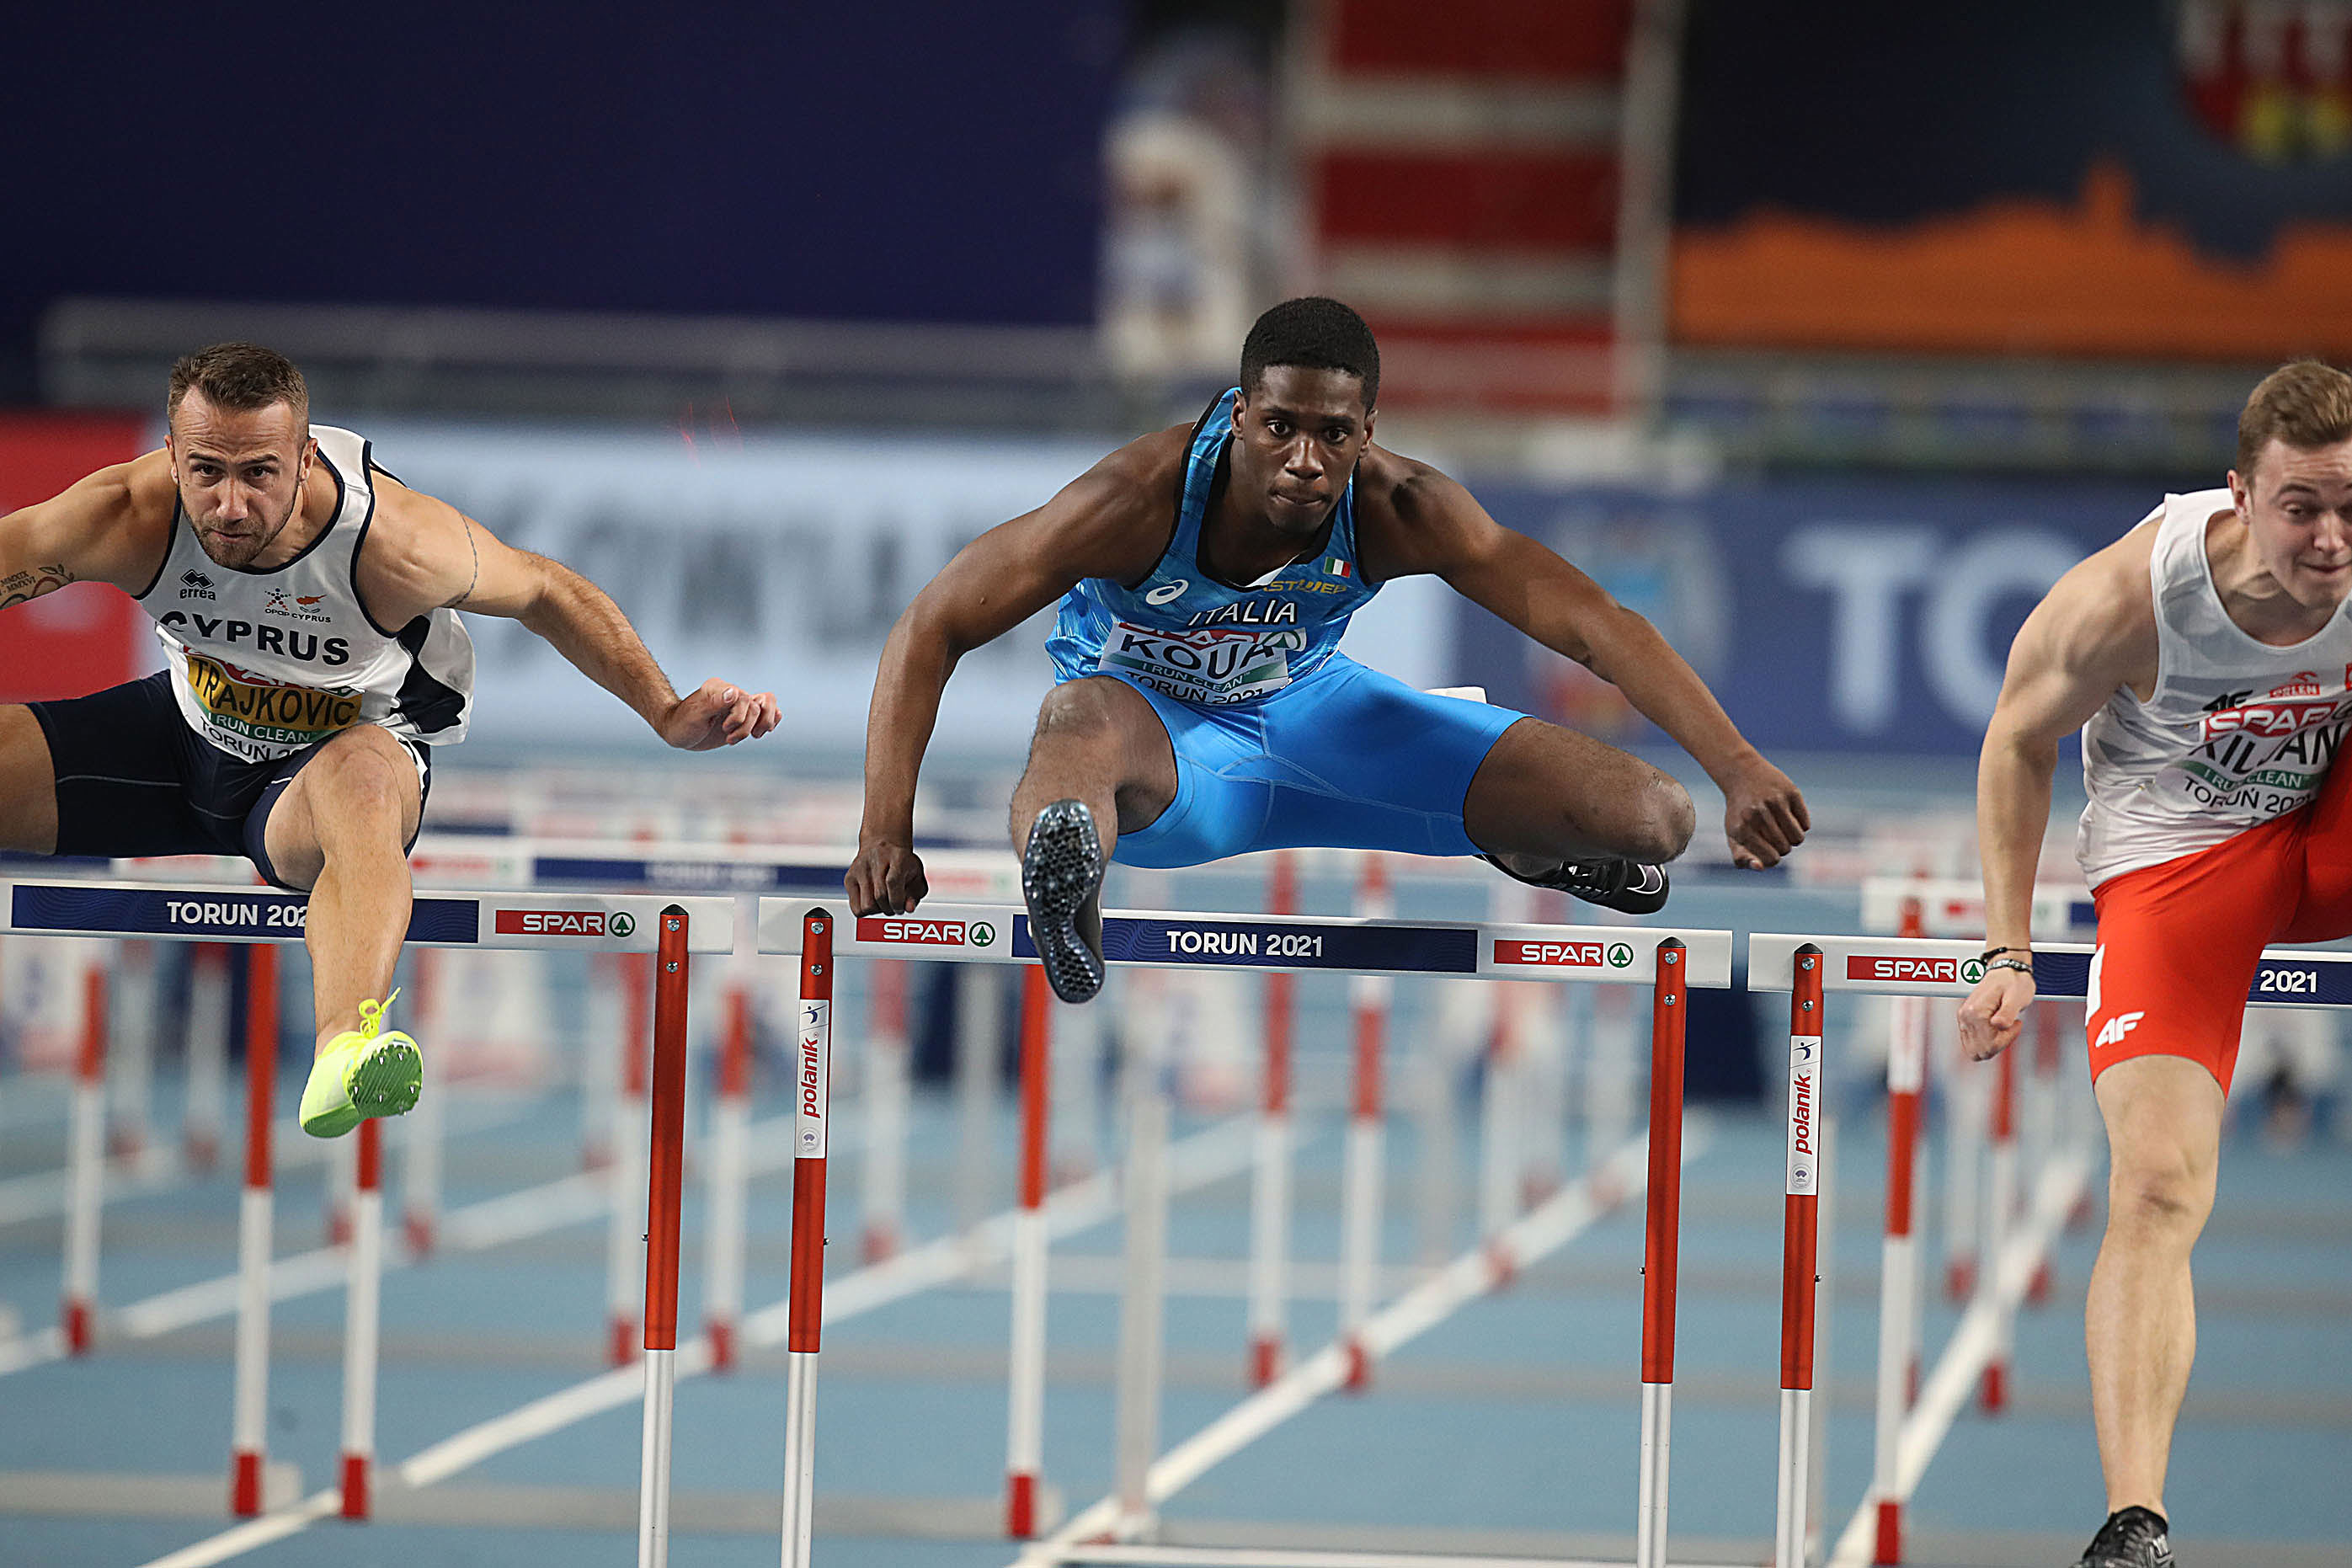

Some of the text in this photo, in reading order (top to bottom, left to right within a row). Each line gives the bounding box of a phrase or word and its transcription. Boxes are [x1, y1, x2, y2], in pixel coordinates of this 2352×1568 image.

[291, 612, 331, 623] CYPRUS
[1187, 599, 1296, 627] ITALIA
[159, 611, 349, 666] CYPRUS
[1120, 633, 1275, 680] KOUA
[1151, 665, 1187, 681] RUN
[1192, 675, 1243, 692] CLEAN
[192, 657, 355, 727] TRAJKOVIC
[216, 714, 250, 735] RUN
[253, 726, 311, 743] CLEAN
[2211, 776, 2238, 790] RU
[167, 901, 309, 927] TORUN 202
[523, 914, 604, 933] SPAR
[883, 922, 963, 942] SPAR
[1166, 931, 1322, 957] TORUN 2021
[1521, 944, 1602, 963] SPAR
[1874, 959, 1955, 979] SPAR
[2259, 969, 2317, 993] 2021
[800, 1037, 821, 1118] polanik
[1792, 1072, 1813, 1155] polanik
